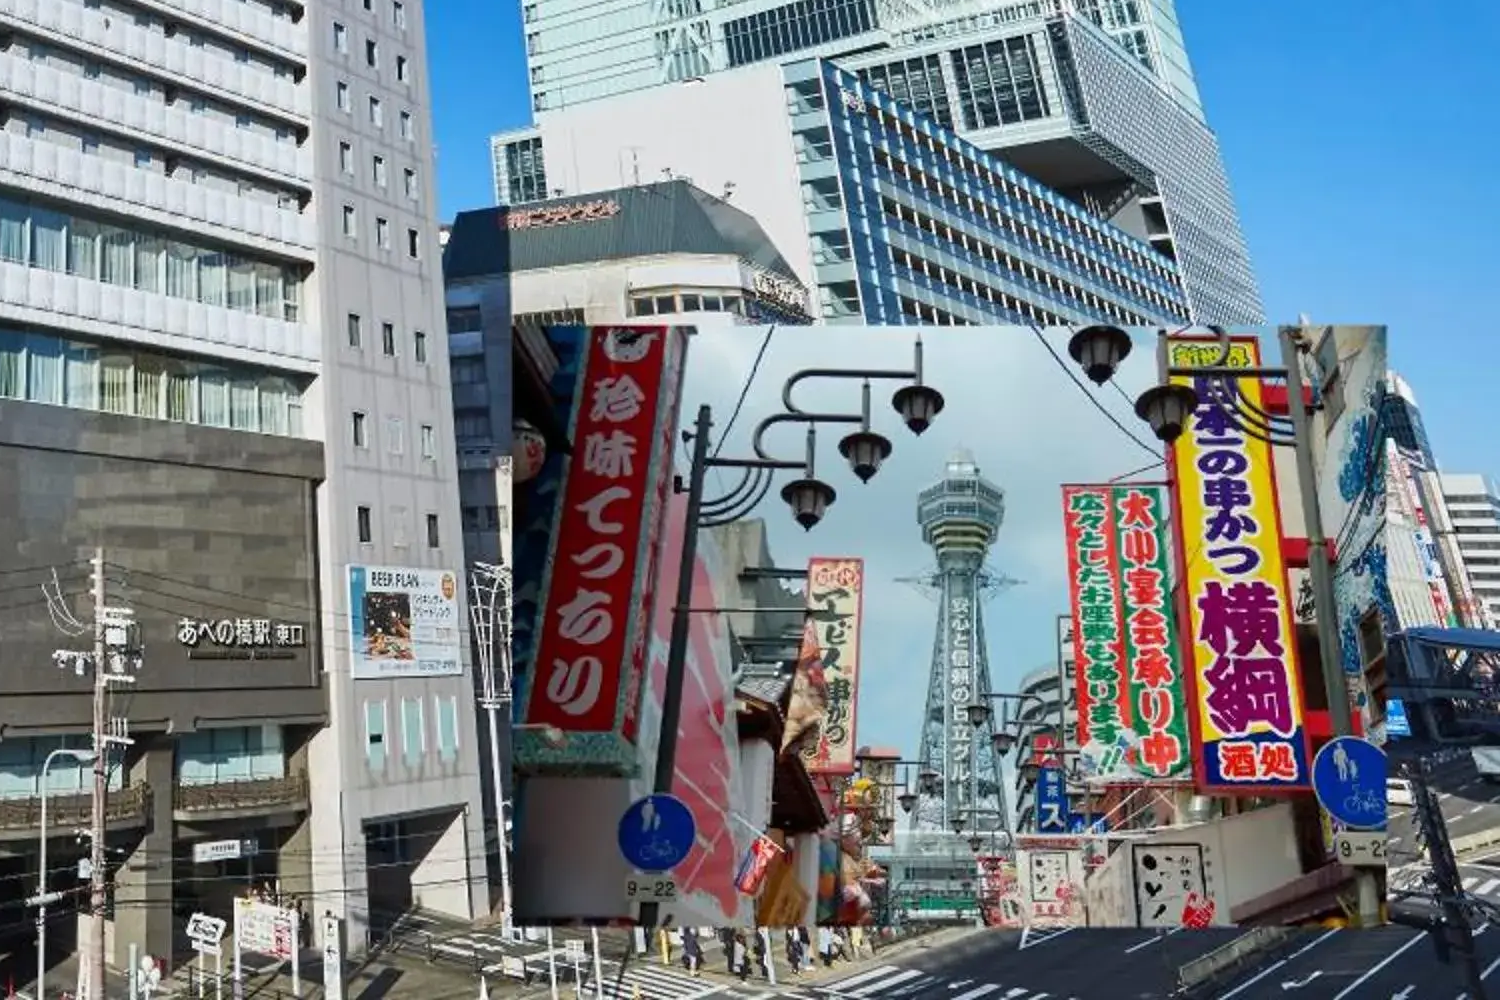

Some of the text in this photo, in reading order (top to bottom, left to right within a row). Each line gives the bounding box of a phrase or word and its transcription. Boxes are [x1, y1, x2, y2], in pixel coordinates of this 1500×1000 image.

[371, 571, 394, 588] BEER
[395, 573, 420, 589] PLAN
[178, 617, 305, 646] あべの橋駅 東口
[1197, 580, 1294, 735] 横綱
[1219, 741, 1299, 781] 酒処
[1340, 840, 1387, 858] 9-2
[626, 880, 676, 897] 9-22
